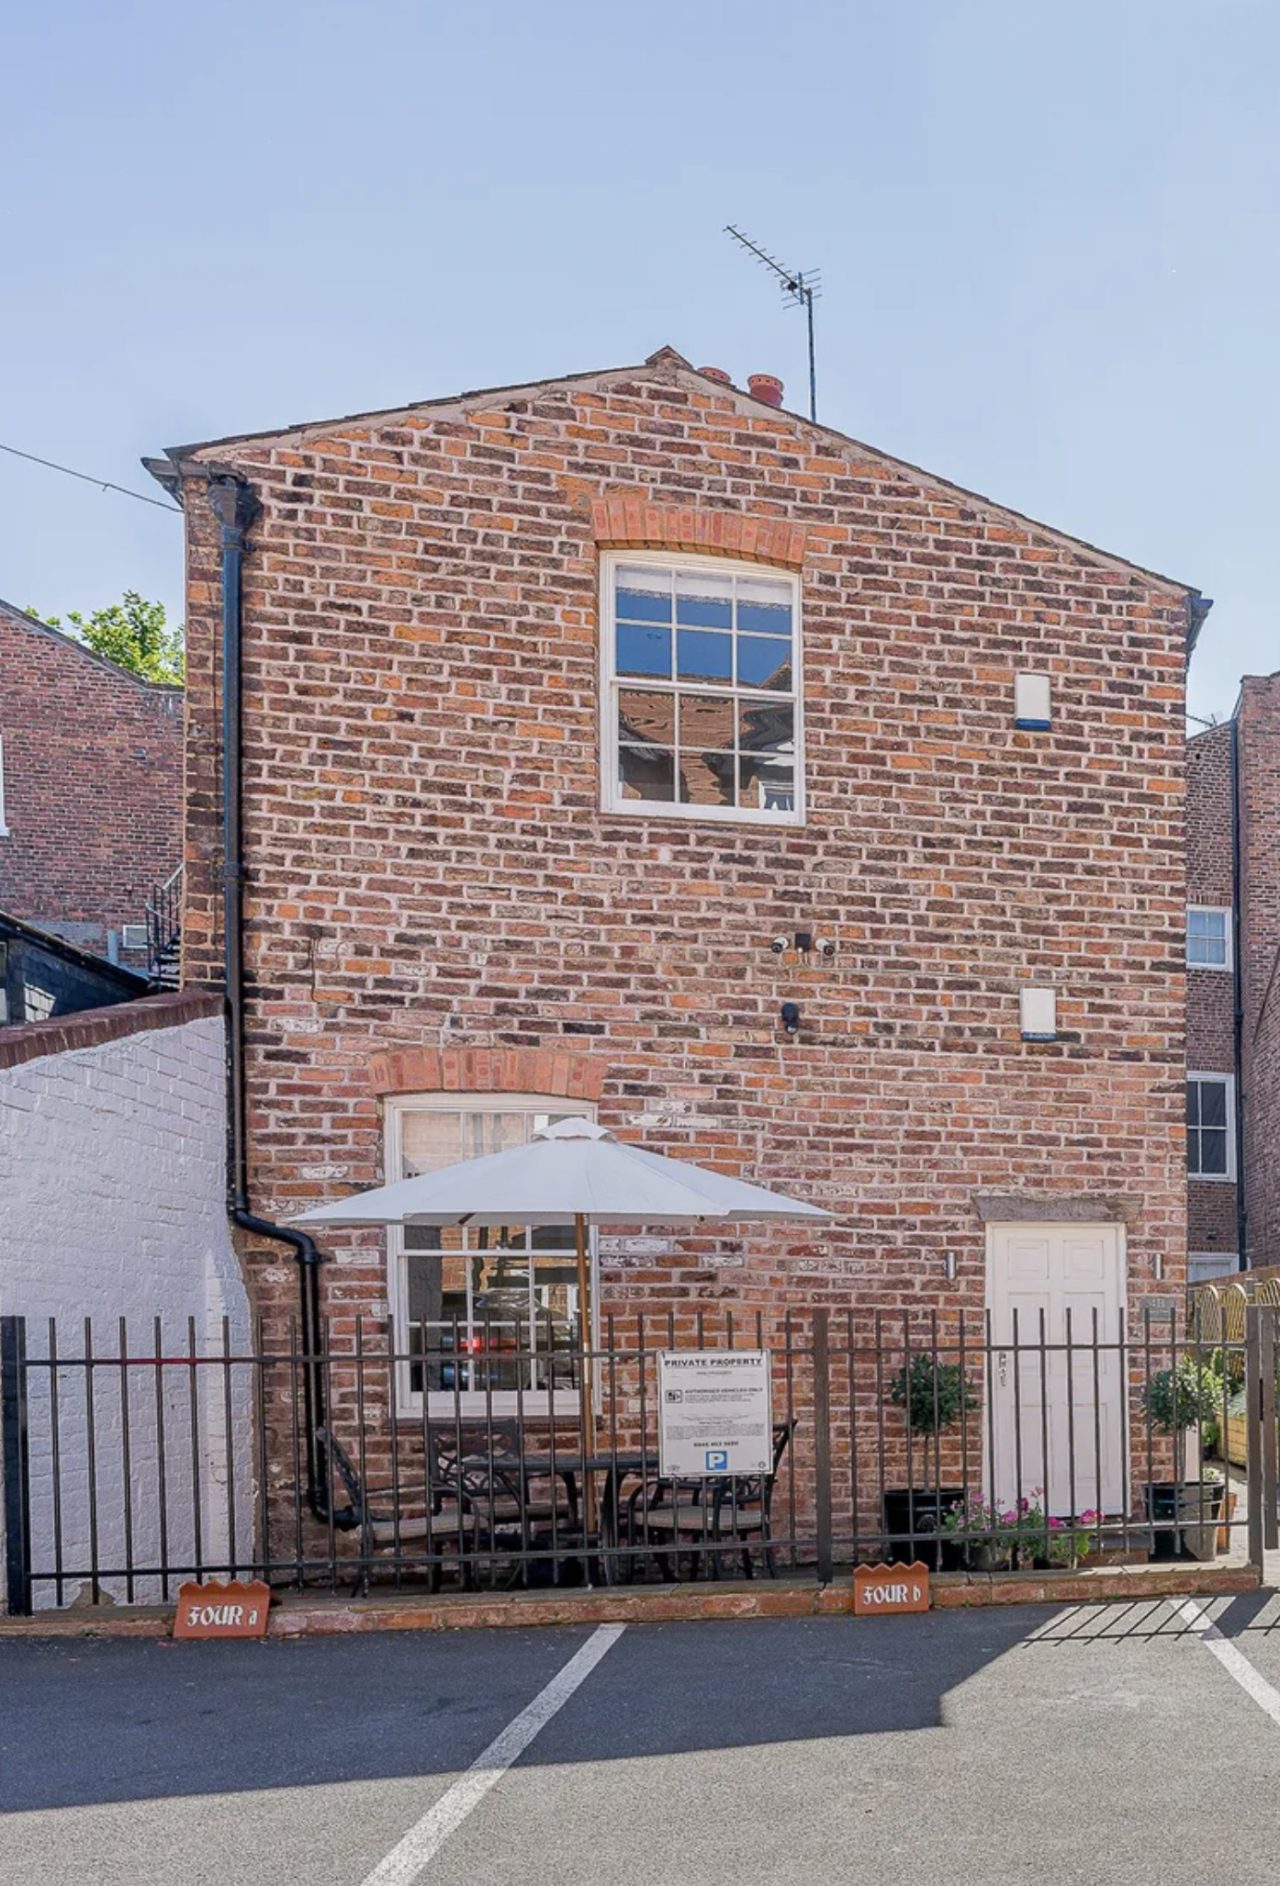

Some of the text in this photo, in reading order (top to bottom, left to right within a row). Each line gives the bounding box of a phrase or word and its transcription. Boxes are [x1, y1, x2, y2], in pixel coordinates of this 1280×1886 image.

[664, 1358, 762, 1367] PRIVATE PROPERTY
[863, 1583, 909, 1605] FOUR
[187, 1604, 258, 1627] FOUR a
